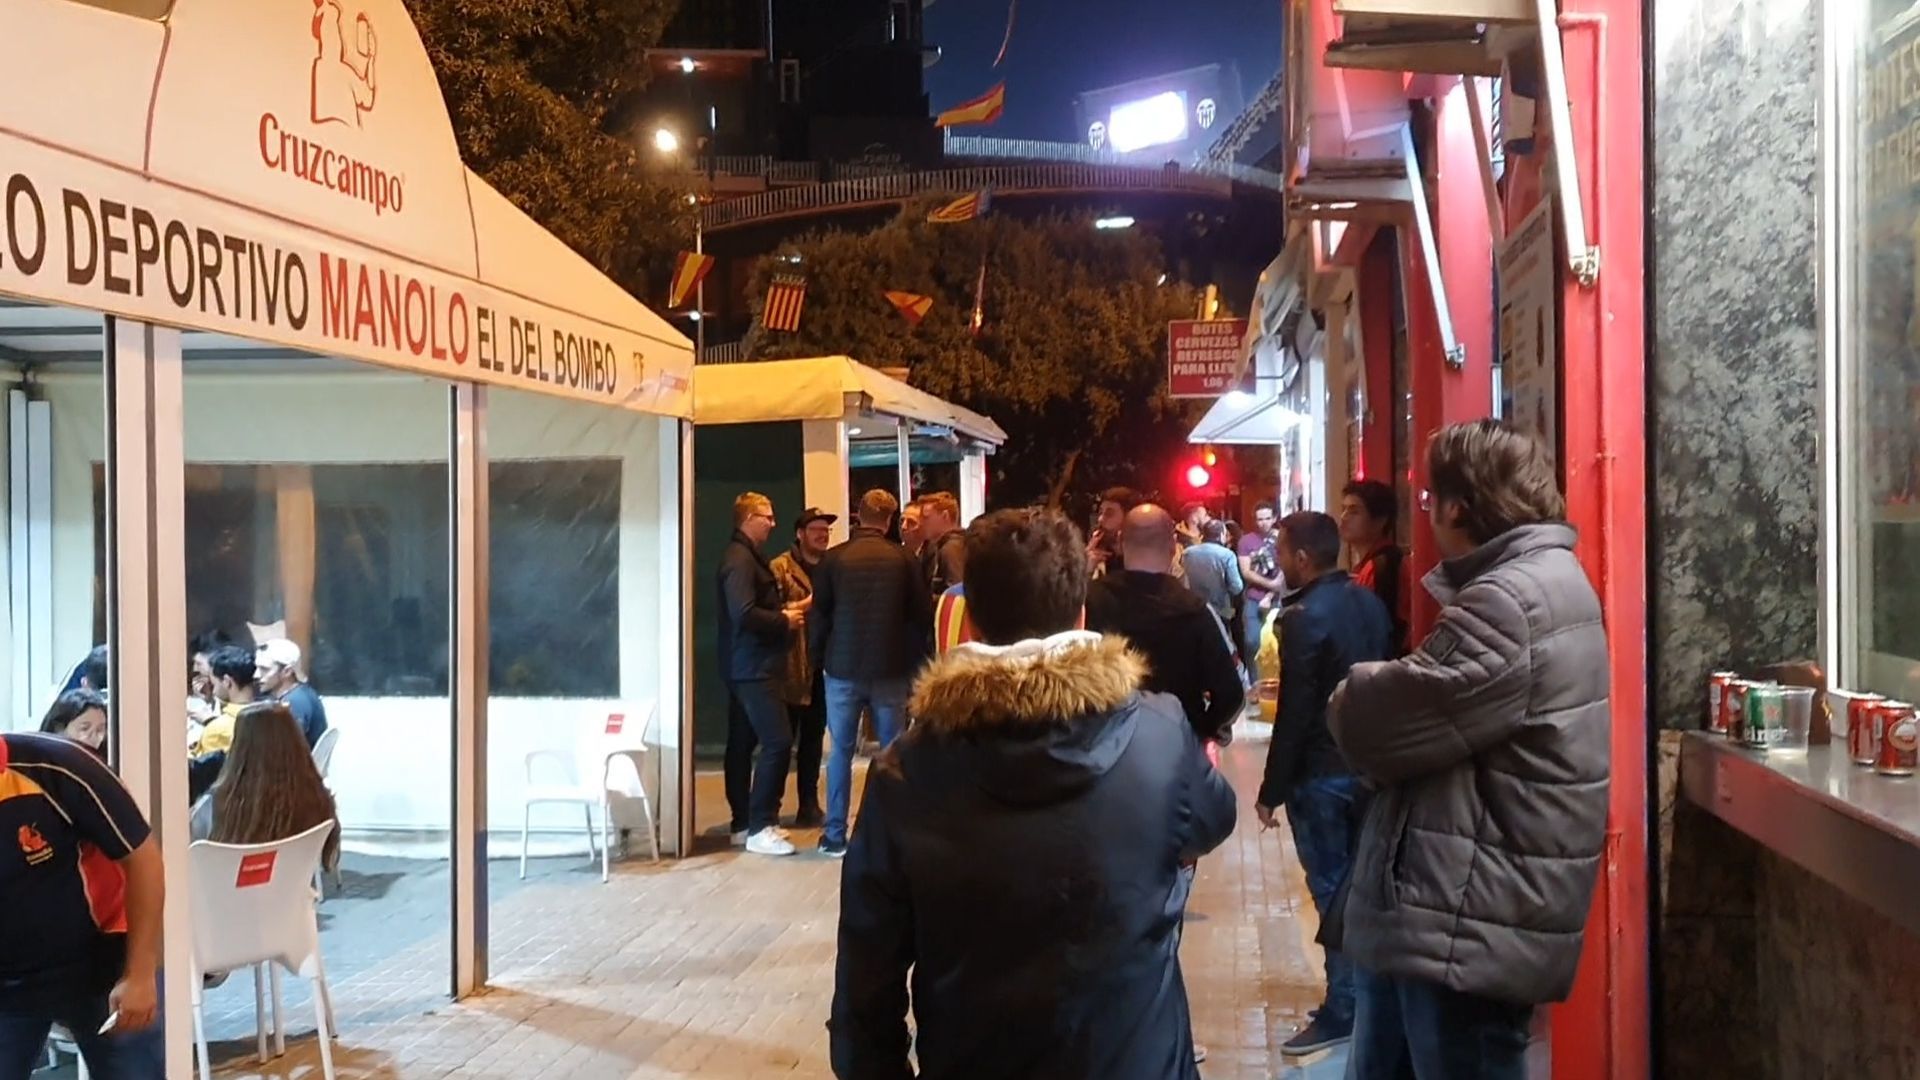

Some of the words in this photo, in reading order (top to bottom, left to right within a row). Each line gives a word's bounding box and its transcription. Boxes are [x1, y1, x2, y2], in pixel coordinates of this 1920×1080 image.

[259, 112, 403, 216] Cruzcampo
[0, 172, 46, 276] O
[62, 187, 309, 331] DEPORTIVO
[320, 252, 469, 365] MANOLO
[477, 306, 504, 372] EL
[510, 315, 549, 382] DEL
[553, 329, 617, 395] BOMBO
[1175, 336, 1239, 349] CERVEZAS
[1176, 349, 1240, 362] REFRESCO
[1173, 363, 1206, 375] PARA
